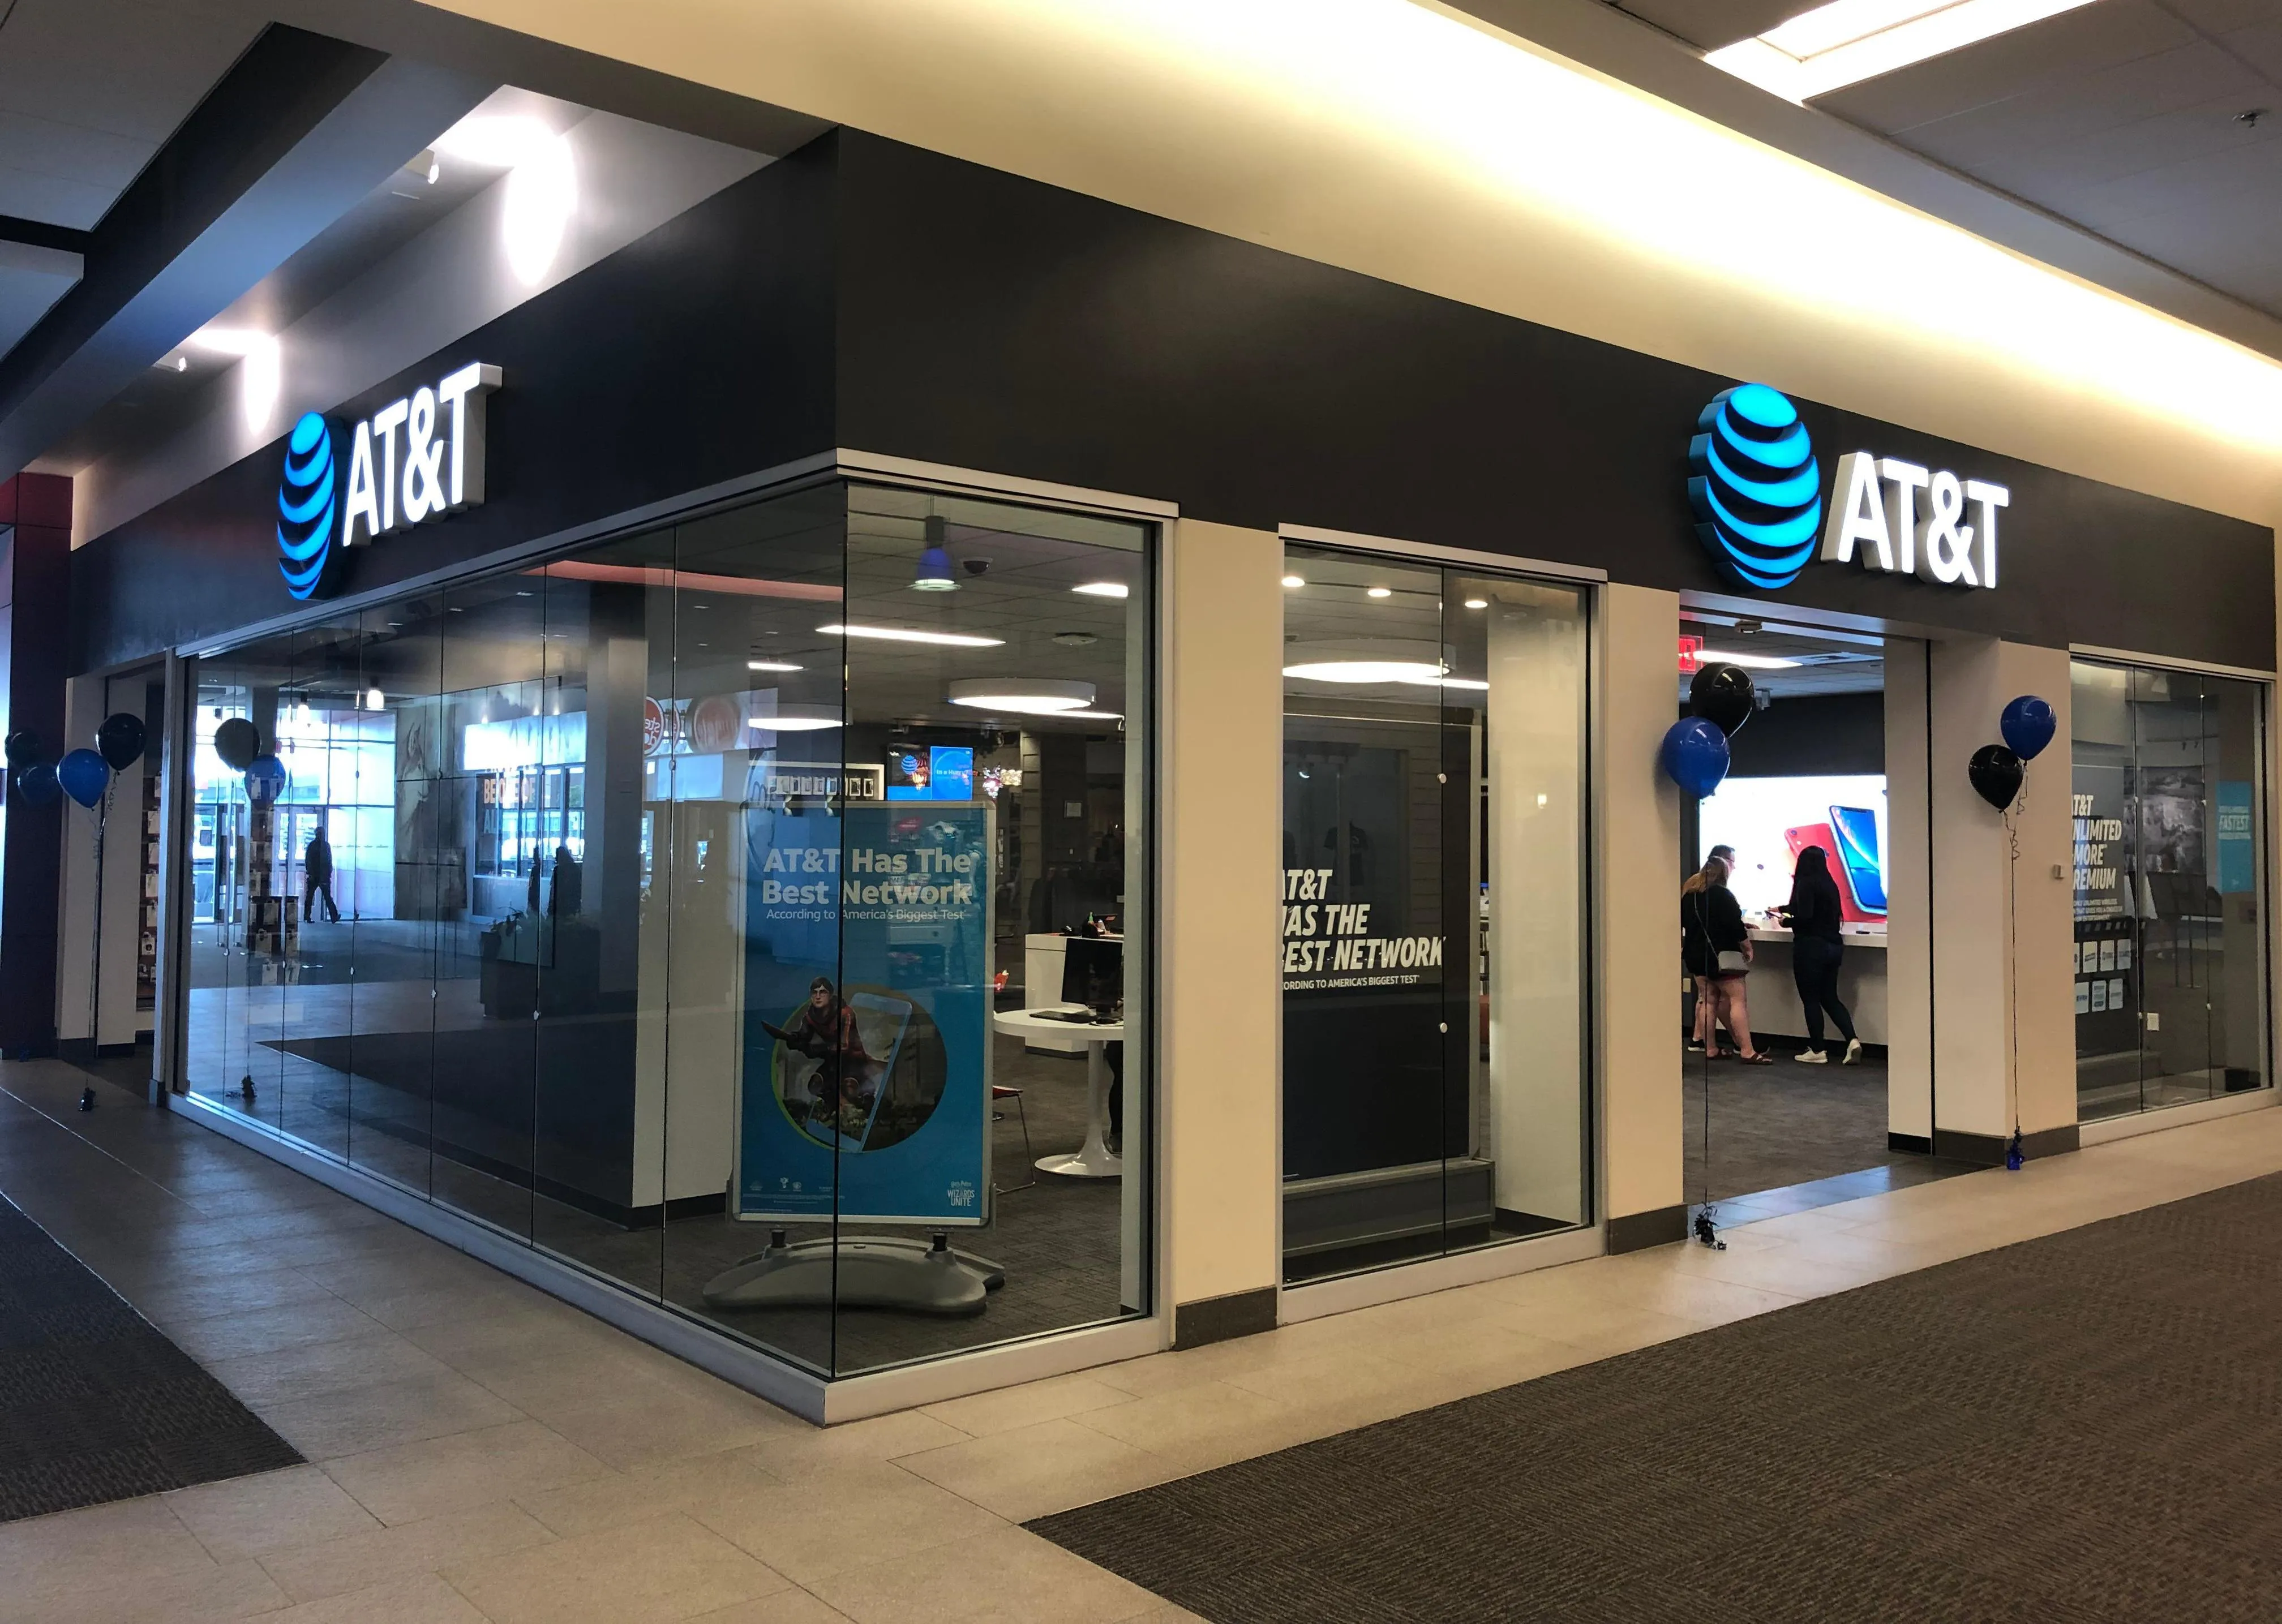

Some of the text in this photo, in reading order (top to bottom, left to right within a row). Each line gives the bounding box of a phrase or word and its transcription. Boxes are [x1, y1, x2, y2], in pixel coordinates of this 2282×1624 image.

[343, 362, 482, 547] AT&T
[1834, 451, 2010, 589] AT&T
[2073, 794, 2094, 816] T&T
[2073, 819, 2122, 841] NLIMITED
[763, 847, 971, 873] AT&T Has The
[2073, 867, 2116, 890] REMIUM
[762, 879, 972, 905] Best Network
[766, 909, 821, 922] According
[823, 910, 836, 920] to
[842, 909, 893, 920] America's
[896, 909, 937, 922] Biggest
[1325, 904, 1371, 935] THE
[1282, 936, 1447, 973] EST NETWORK
[1283, 980, 1315, 991] ORDING
[1315, 979, 1327, 989] TO
[1328, 977, 1367, 988] AMERICA'S
[1369, 976, 1399, 986] BIGGEST
